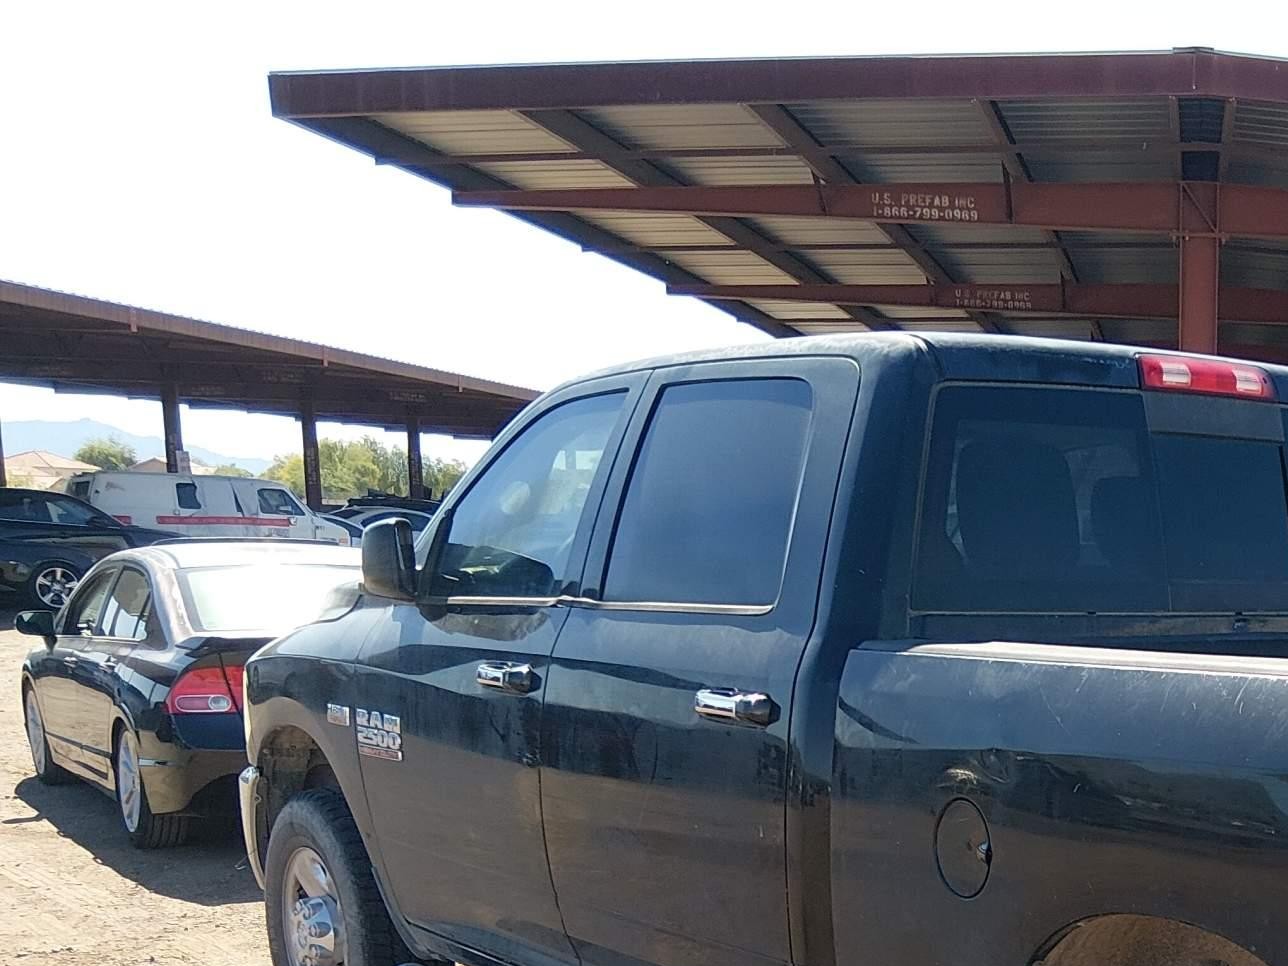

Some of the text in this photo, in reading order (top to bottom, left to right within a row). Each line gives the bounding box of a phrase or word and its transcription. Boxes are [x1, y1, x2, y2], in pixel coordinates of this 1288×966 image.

[871, 192, 895, 206] U.S.
[901, 193, 950, 207] PREFAB
[356, 708, 401, 734] RAM
[357, 727, 402, 750] 2500
